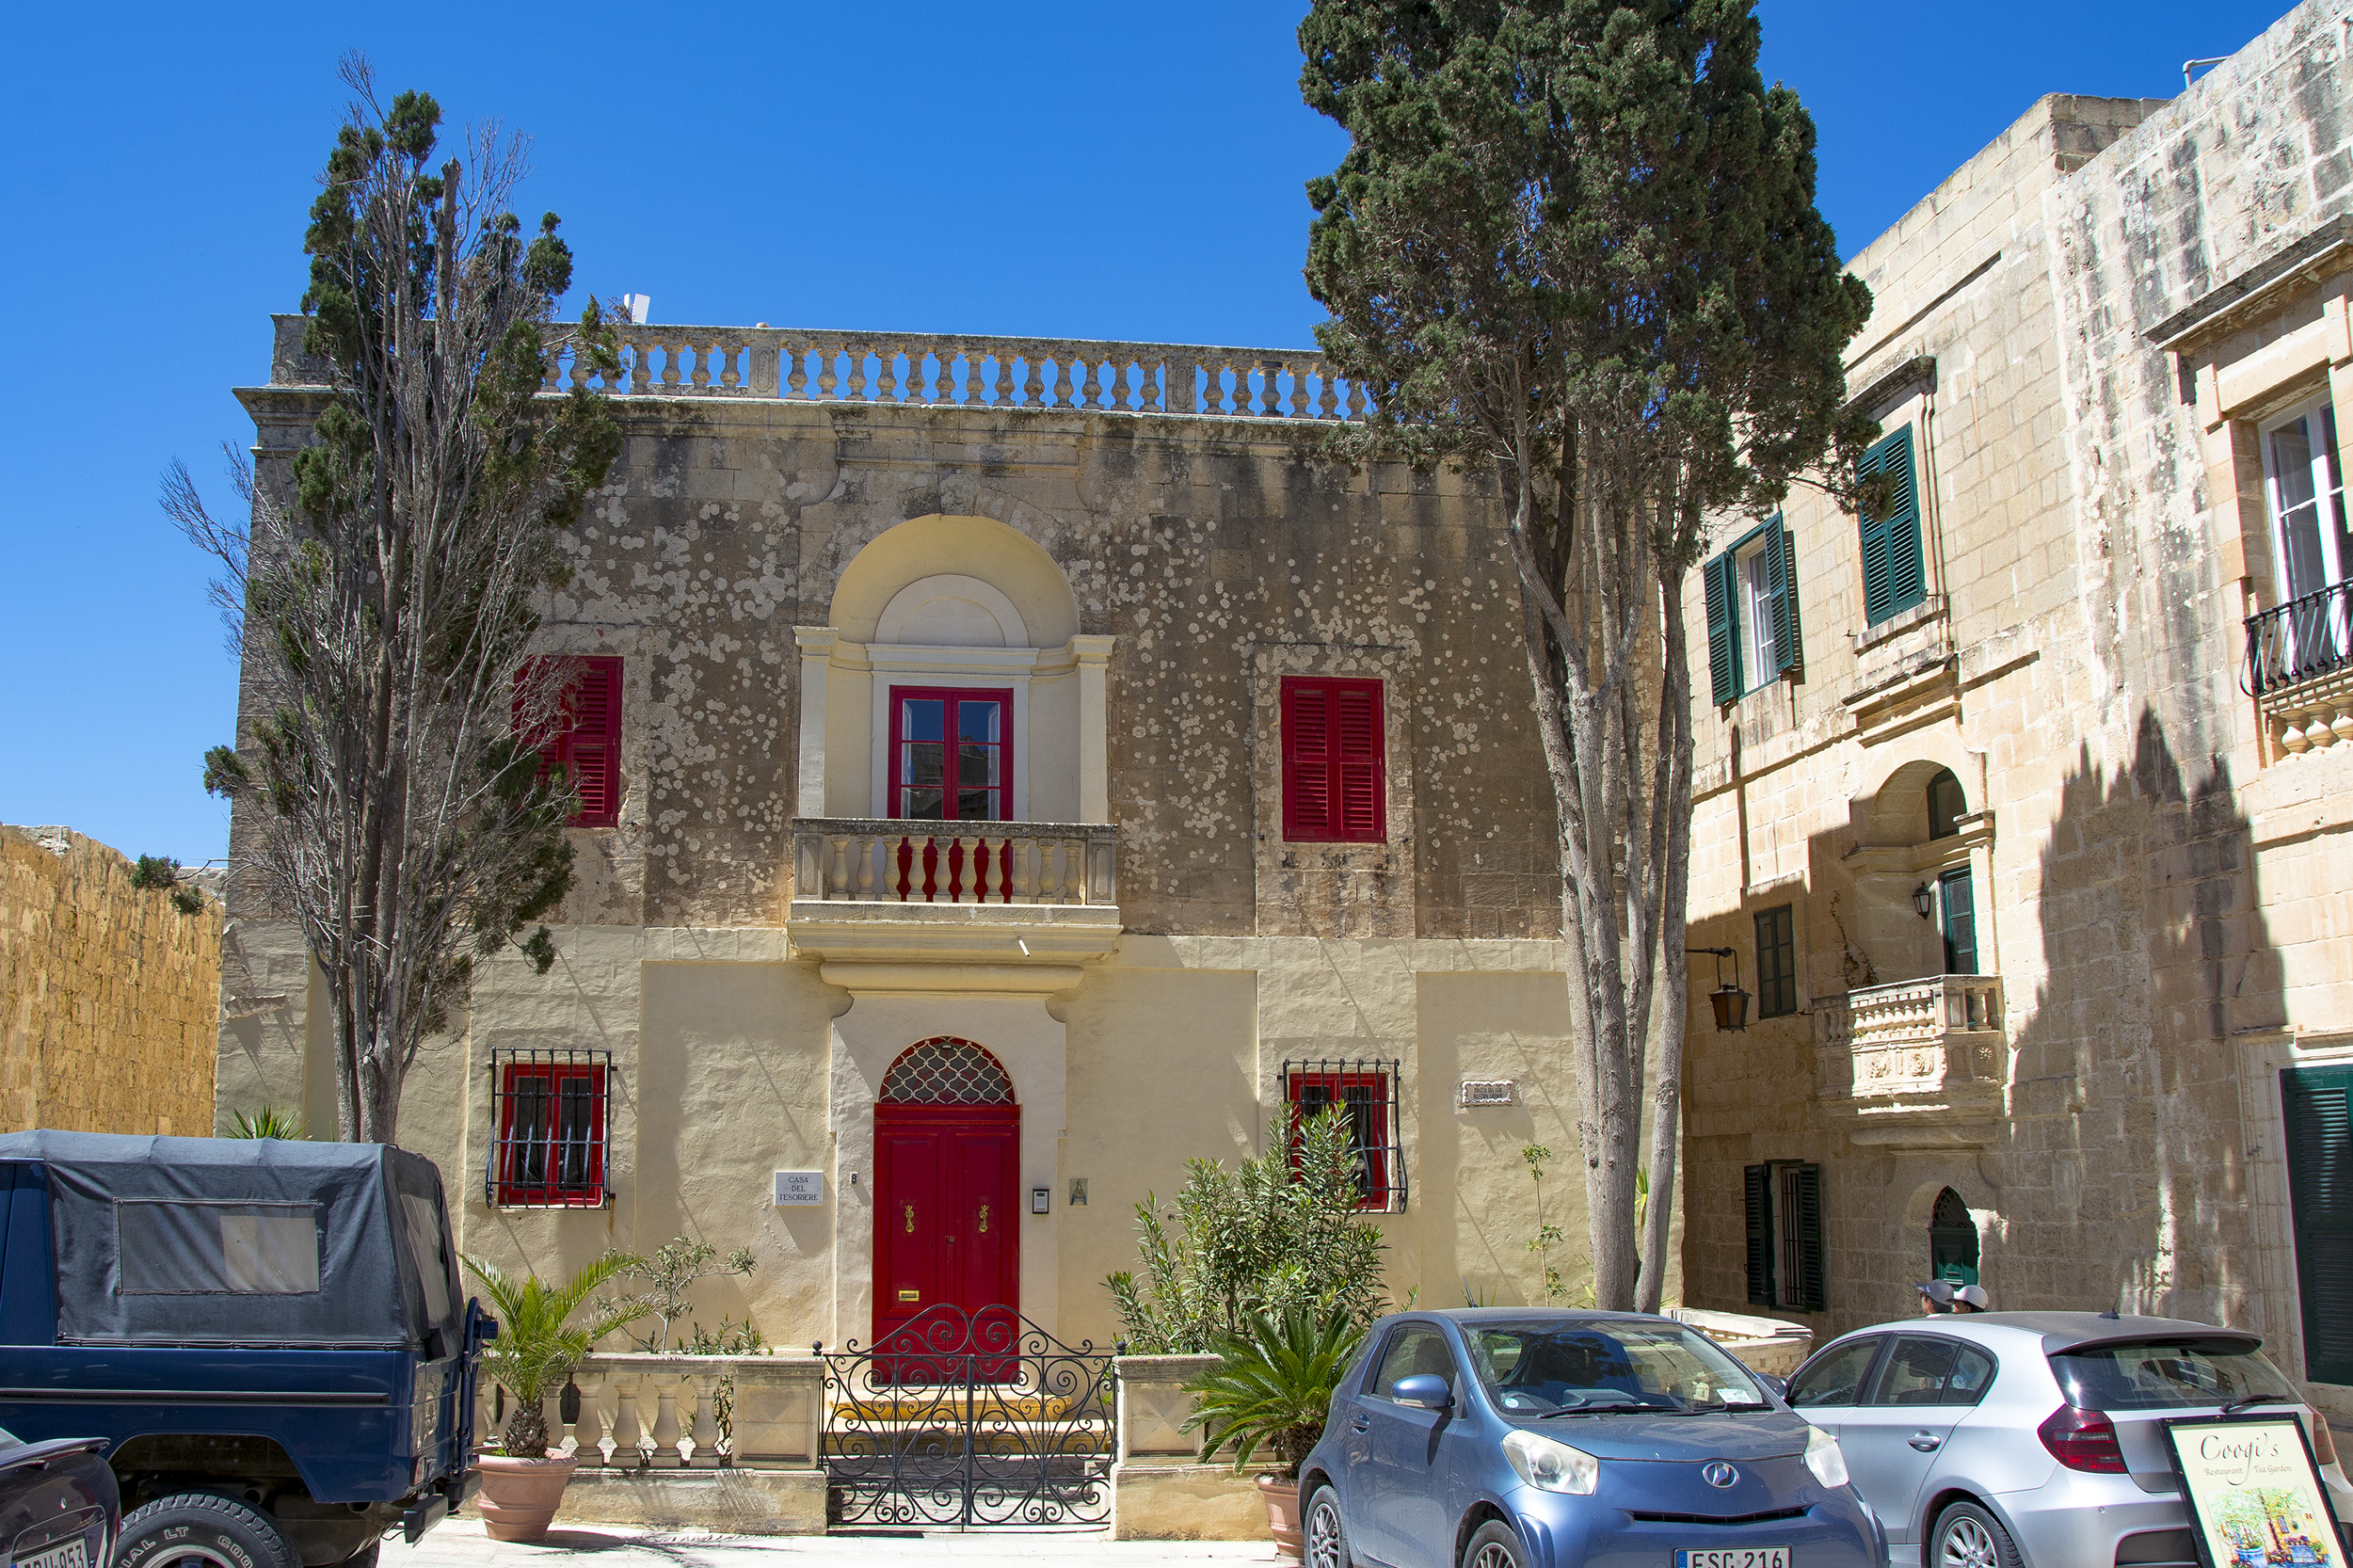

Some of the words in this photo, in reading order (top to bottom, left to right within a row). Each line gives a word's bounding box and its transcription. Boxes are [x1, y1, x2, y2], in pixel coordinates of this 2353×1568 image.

[851, 1174, 857, 1184] 8
[2201, 1432, 2279, 1485] Coogi's
[2203, 1467, 2243, 1477] Restaurant
[2253, 1464, 2266, 1474] Tea
[2266, 1464, 2292, 1475] Garden
[164, 1527, 188, 1540] LT
[1744, 1550, 1783, 1568] 216
